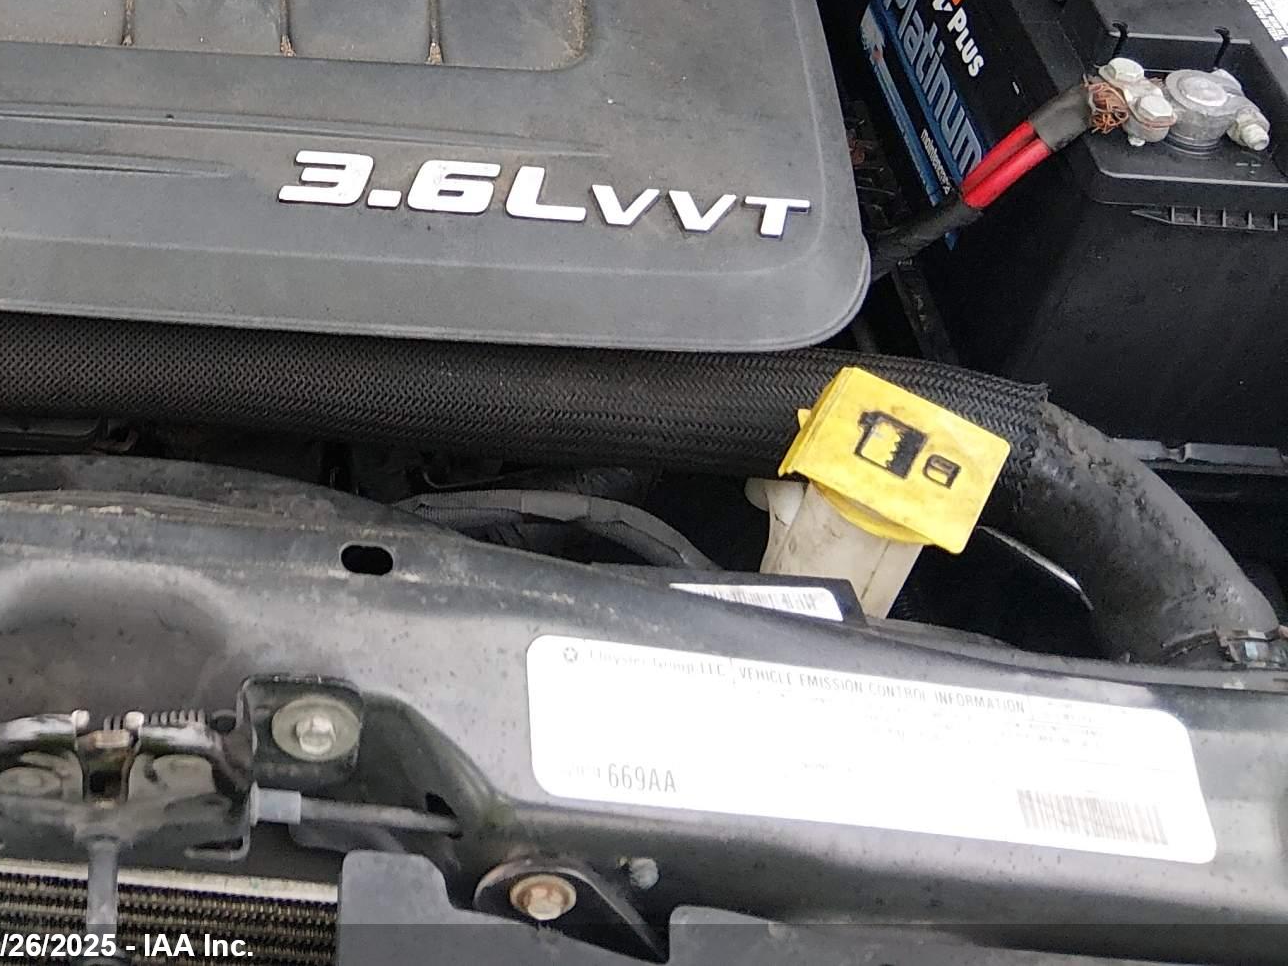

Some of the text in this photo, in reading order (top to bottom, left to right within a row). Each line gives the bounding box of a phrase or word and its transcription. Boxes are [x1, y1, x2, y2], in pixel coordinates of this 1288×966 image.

[946, 6, 984, 78] PLUS
[738, 666, 1026, 714] VEHICLE EMISSION CONTROL INFORMATION
